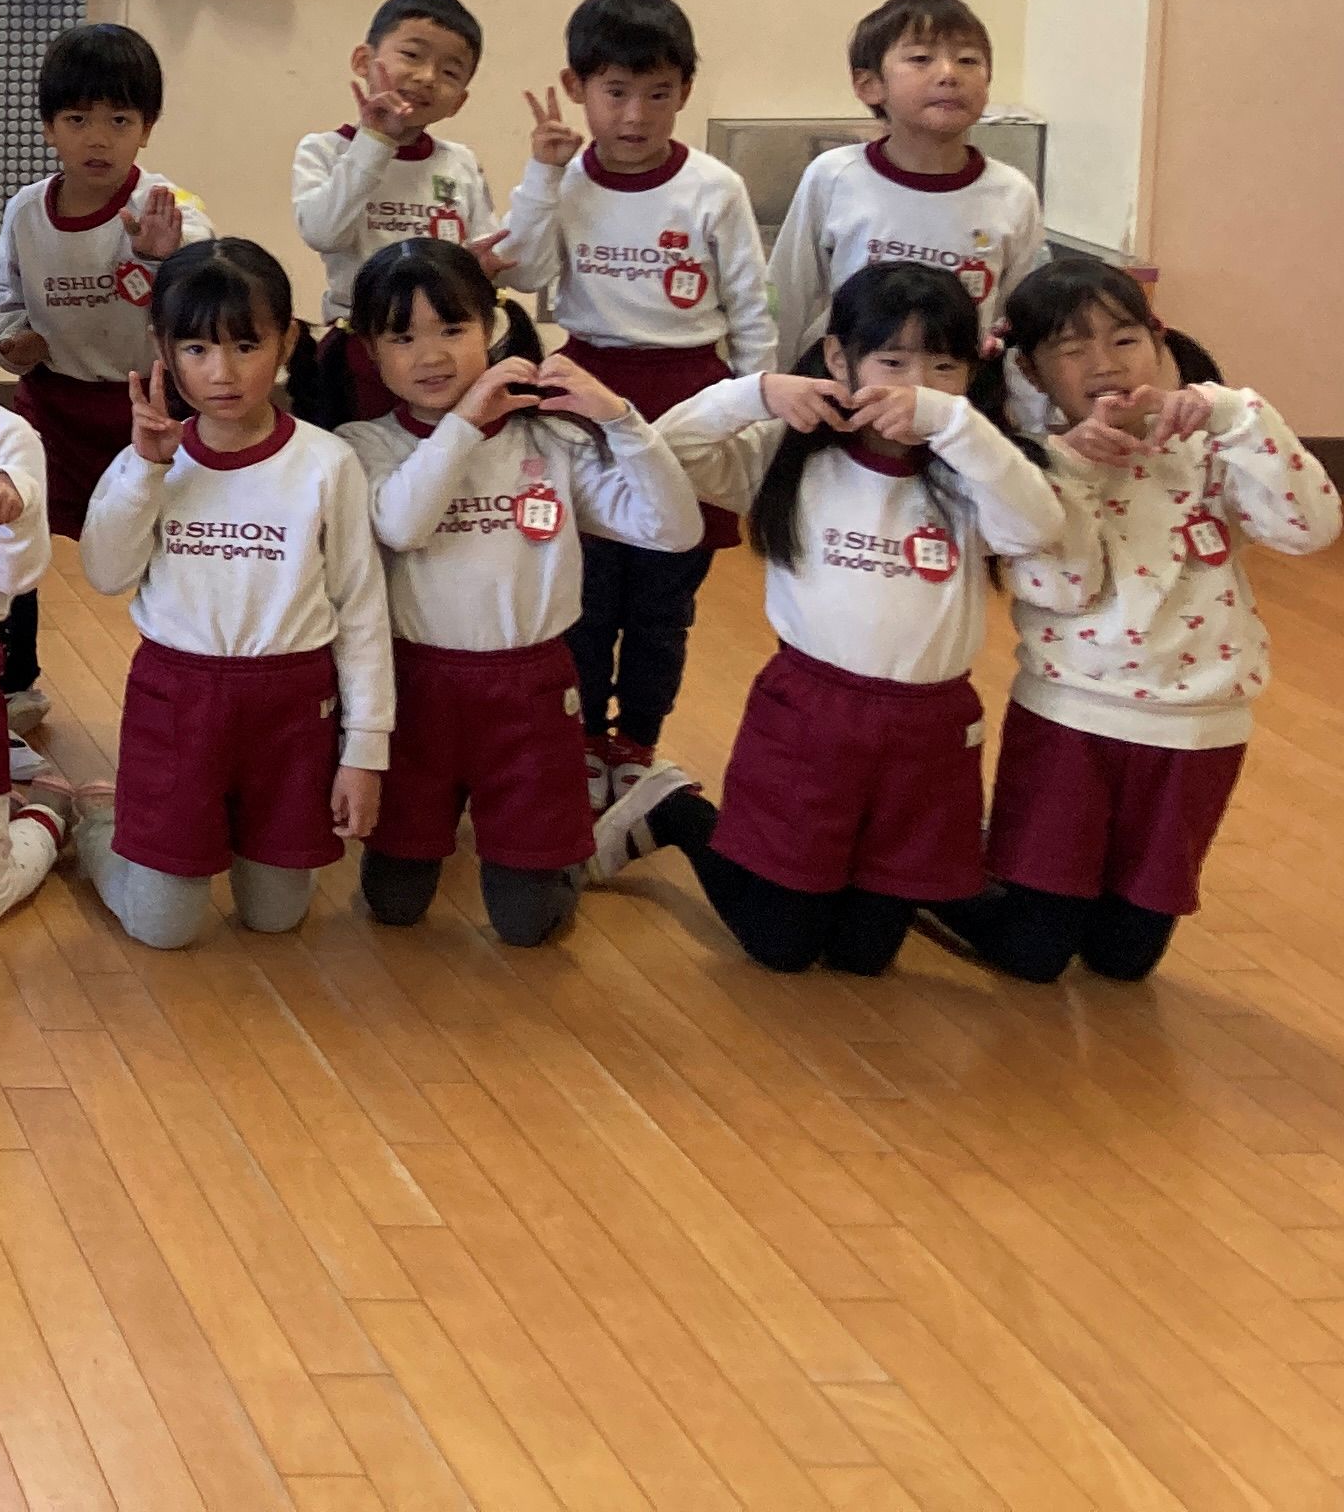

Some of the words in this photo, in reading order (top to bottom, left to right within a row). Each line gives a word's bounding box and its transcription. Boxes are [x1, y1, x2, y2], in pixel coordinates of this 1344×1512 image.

[886, 240, 961, 267] SHIO
[57, 274, 115, 291] SHIO
[186, 521, 287, 542] SHION
[166, 538, 285, 560] kindergarten
[845, 531, 900, 556] SHI
